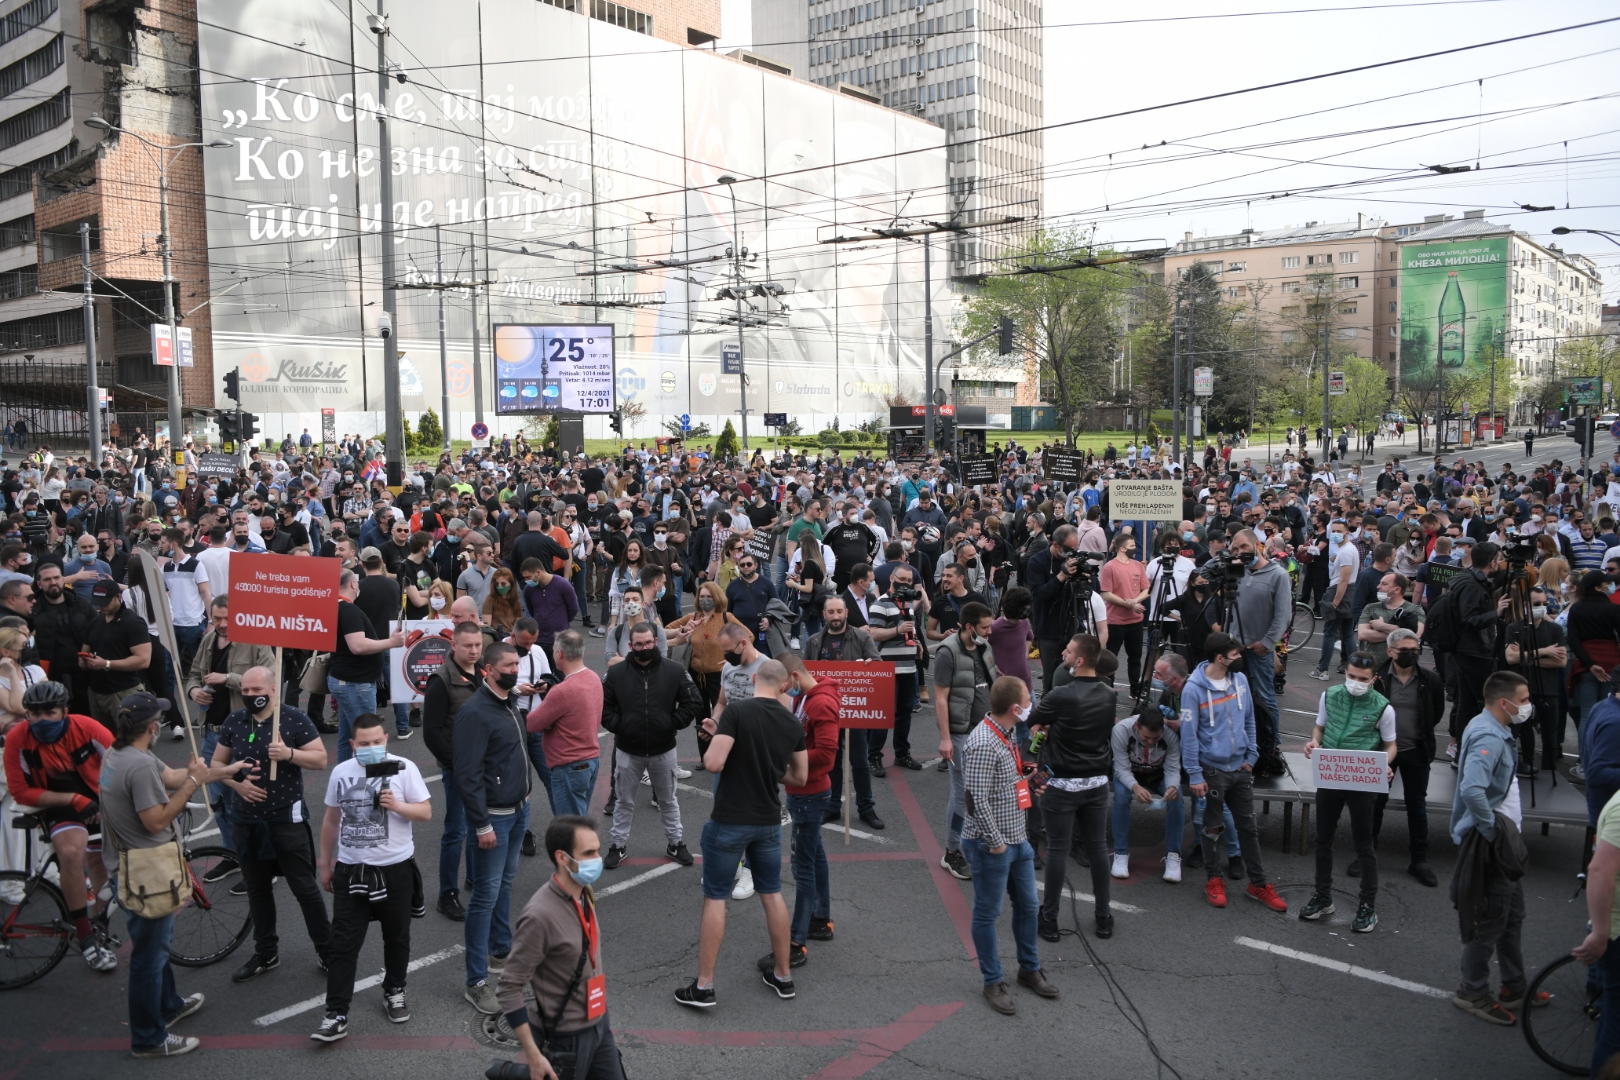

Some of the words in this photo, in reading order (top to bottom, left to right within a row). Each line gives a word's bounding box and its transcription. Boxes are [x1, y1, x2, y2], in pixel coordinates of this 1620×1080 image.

[234, 136, 304, 181] Ко
[318, 147, 375, 179] не
[390, 146, 463, 176] зна
[474, 145, 518, 172] за
[359, 199, 435, 244] иде
[1408, 259, 1442, 269] КНЕЗА
[1445, 253, 1500, 266] МИЛОША!
[283, 386, 349, 395] КОРПОРАЦИЈА
[786, 382, 831, 395] Sloboda
[580, 398, 610, 408] 17:01
[217, 466, 235, 474] DECU.
[1153, 483, 1174, 491] BAŠTA
[1430, 566, 1442, 574] ISTA
[255, 571, 267, 580] Ne
[269, 572, 290, 582] treba
[292, 575, 310, 583] vam
[1432, 573, 1440, 581] ZA
[263, 585, 289, 595] turista
[290, 587, 332, 599] godišnje?
[235, 612, 276, 629] ONDA
[280, 614, 328, 633] NIŠTA.
[840, 694, 867, 706] ŠEM
[838, 707, 887, 720] ŠTANJU.
[1319, 754, 1355, 764] PUSTITE
[1357, 756, 1376, 765] NAS
[1318, 763, 1332, 772] DA
[1334, 763, 1366, 774] ŽIVIMO
[1367, 766, 1383, 775] OD
[1320, 772, 1350, 782] NAŠEG
[1352, 775, 1381, 785] RADA!
